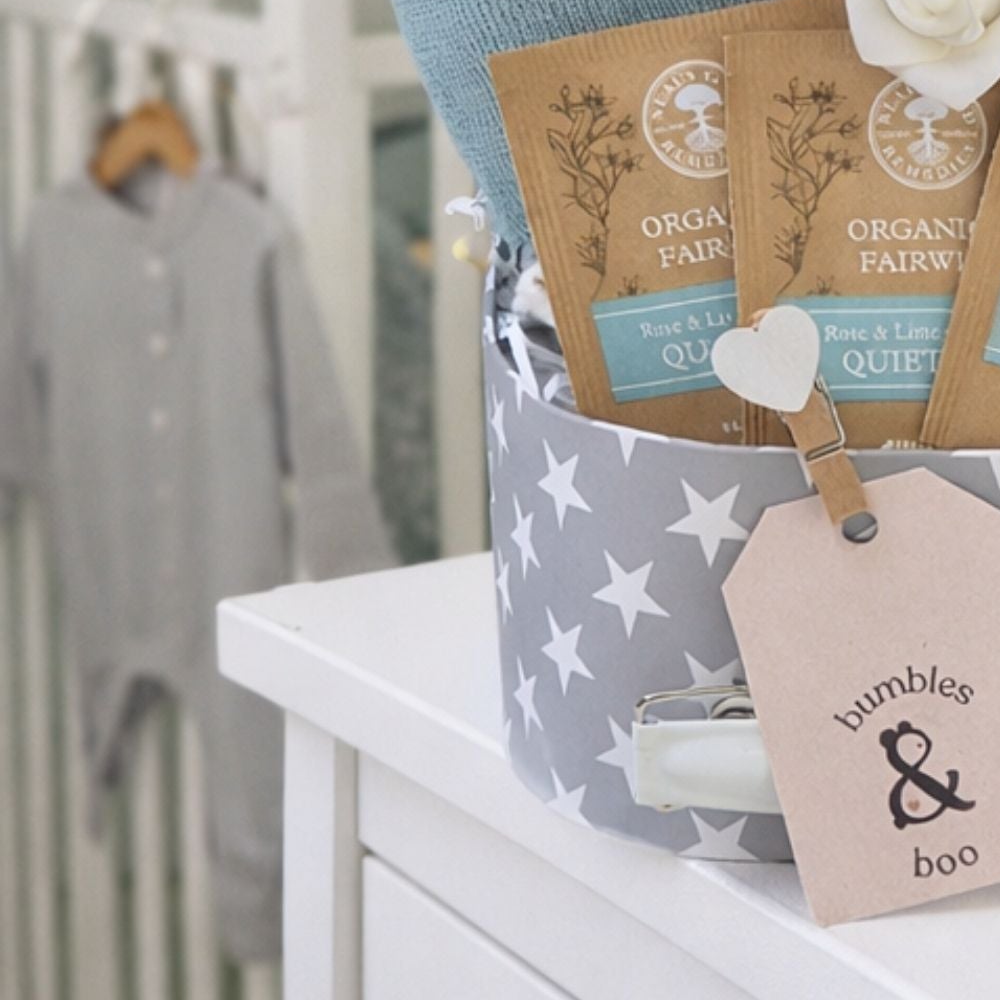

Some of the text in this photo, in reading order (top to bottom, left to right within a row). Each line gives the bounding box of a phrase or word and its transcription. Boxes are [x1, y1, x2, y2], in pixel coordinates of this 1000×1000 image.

[641, 205, 727, 239] ORGA
[657, 237, 732, 269] FAIR
[860, 251, 965, 274] FAIRWI
[688, 314, 702, 331] &
[872, 324, 888, 341] &
[662, 339, 711, 371] QU
[842, 349, 940, 379] QUIET
[834, 666, 975, 733] bumbles
[879, 721, 976, 830] &
[914, 845, 979, 878] boo
